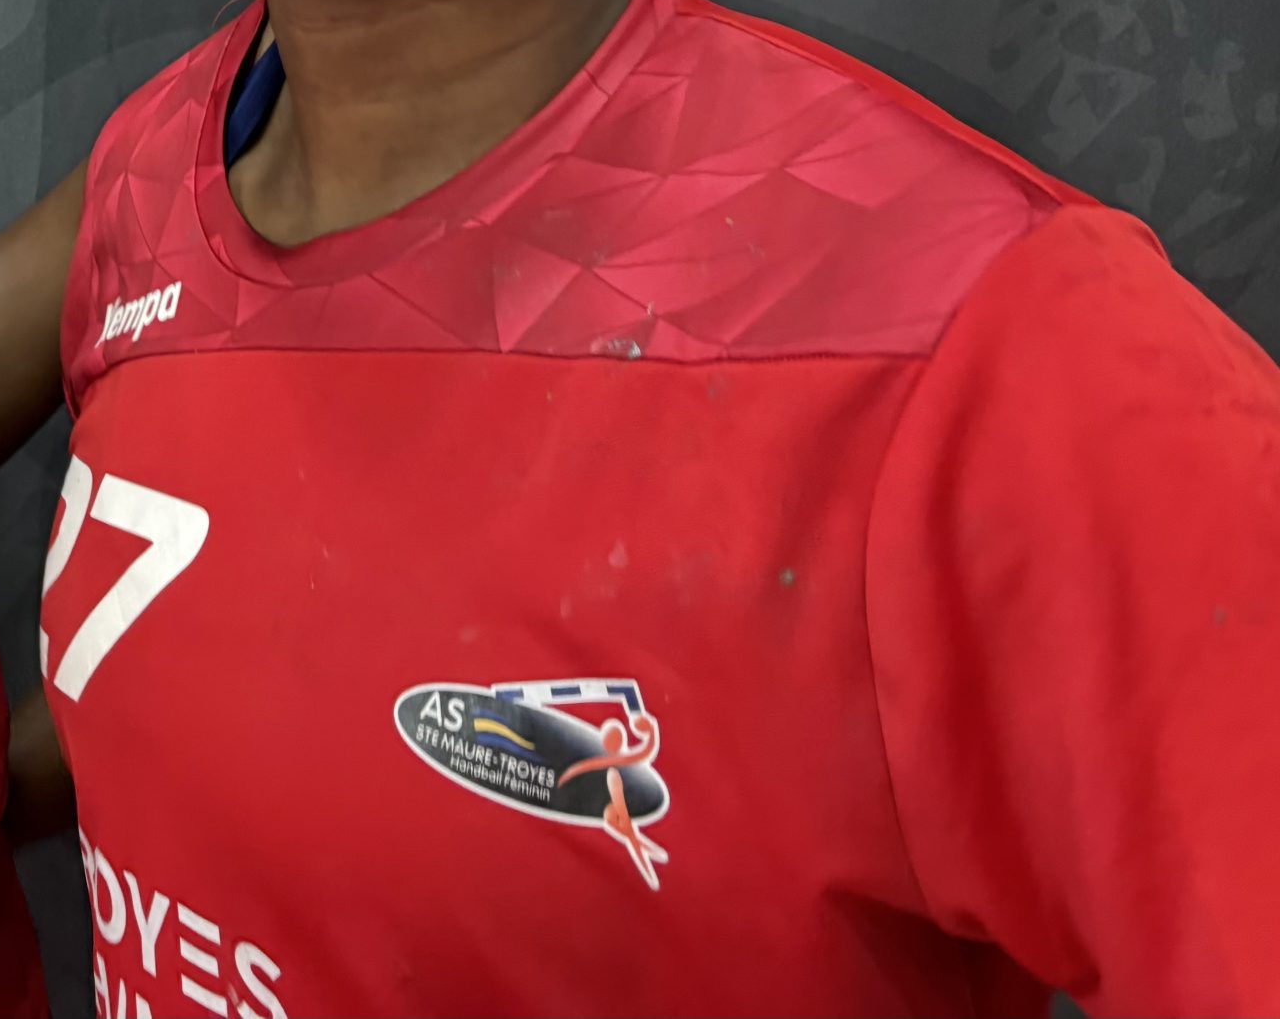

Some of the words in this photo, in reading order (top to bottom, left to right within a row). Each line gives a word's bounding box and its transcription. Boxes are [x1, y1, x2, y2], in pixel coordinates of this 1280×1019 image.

[420, 690, 465, 732] AS
[415, 723, 439, 748] STE
[450, 755, 503, 786] Handball
